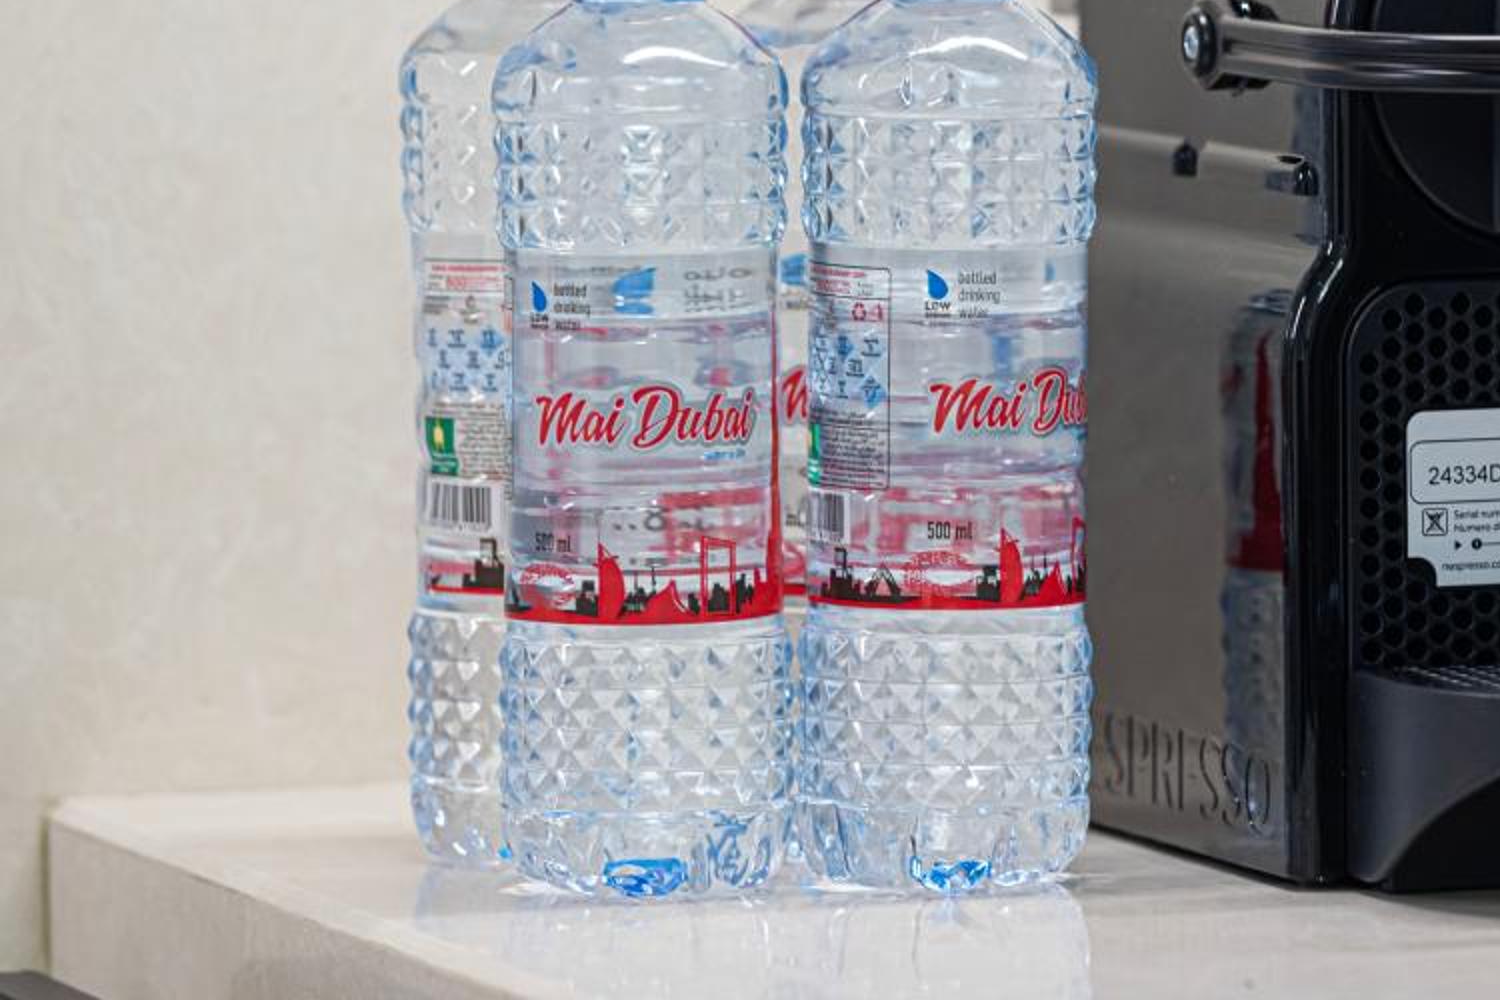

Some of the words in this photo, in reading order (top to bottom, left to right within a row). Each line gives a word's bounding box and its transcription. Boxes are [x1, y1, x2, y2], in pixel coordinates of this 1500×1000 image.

[957, 269, 997, 284] bottled
[957, 288, 1000, 306] drinking
[535, 391, 626, 447] Mai
[632, 384, 754, 448] Dubai
[929, 377, 1028, 434] Mai
[927, 520, 950, 540] 500
[955, 520, 974, 540] ml
[1094, 714, 1273, 834] SPRESSO
